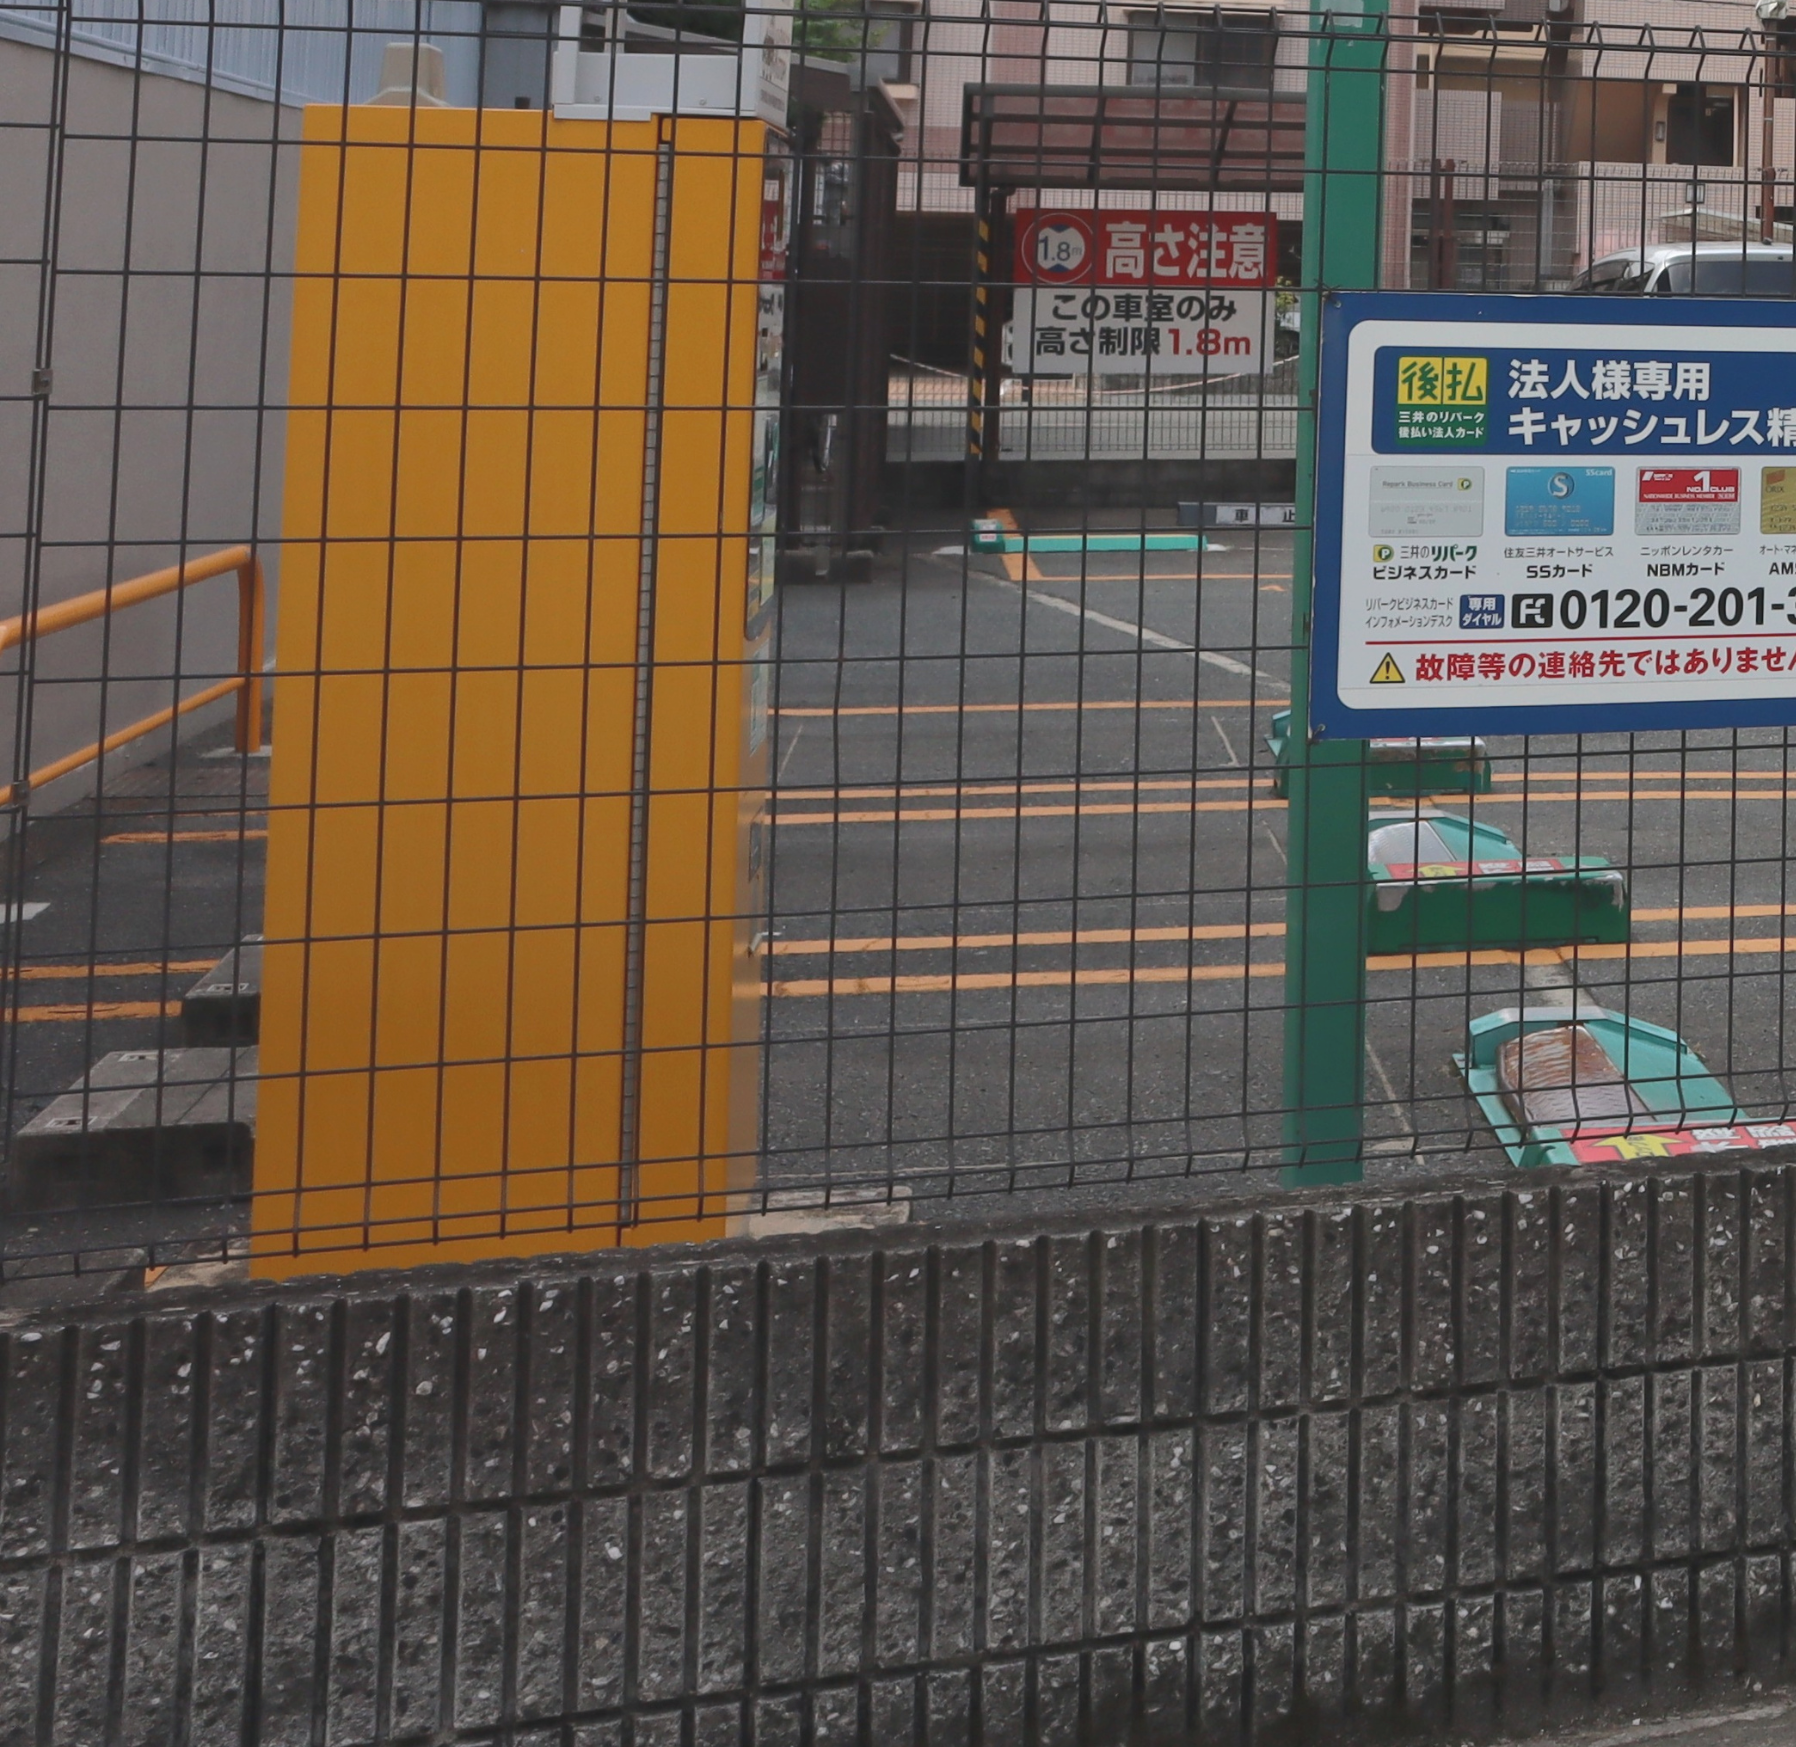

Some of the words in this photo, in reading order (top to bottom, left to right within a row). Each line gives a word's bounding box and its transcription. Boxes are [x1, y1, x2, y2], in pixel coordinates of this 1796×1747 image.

[1106, 221, 1265, 279] 高さ注意
[1052, 294, 1237, 322] この車室のみ
[1400, 360, 1484, 402] 後払
[1507, 359, 1711, 402] 法人様専用
[1398, 411, 1484, 424] 三井のリパーク
[1398, 426, 1485, 439] 後払い法人カード
[1585, 468, 1613, 476] SScard
[1407, 480, 1437, 488] Business
[1400, 545, 1477, 561] 三井のリパーク
[1504, 547, 1614, 559] 住友三井オートサービス
[1640, 545, 1733, 556] ニッポンレンタカー
[1373, 565, 1476, 580] ビジネスカード
[1526, 563, 1593, 578] SSカード
[1647, 562, 1725, 577] NBMカード
[1365, 597, 1454, 612] リパークビジネスカード
[1468, 596, 1496, 612] 専用
[1365, 614, 1453, 629] インフォメーションデスク
[1462, 612, 1502, 627] ダイヤル
